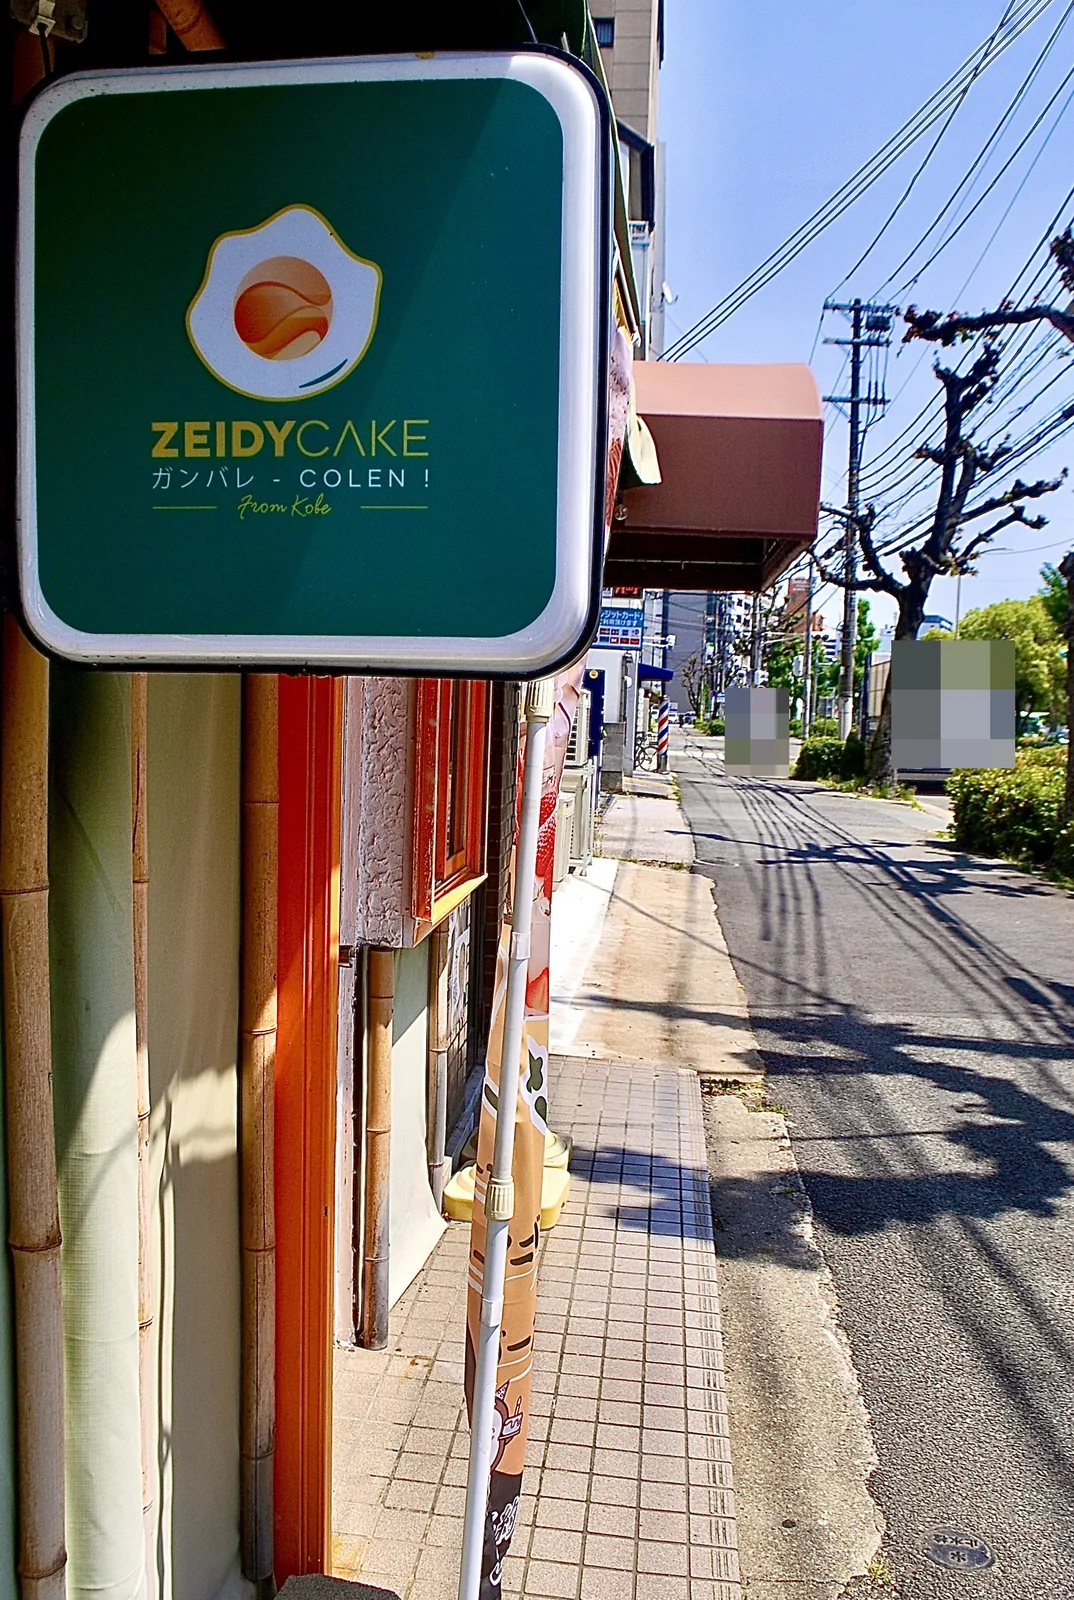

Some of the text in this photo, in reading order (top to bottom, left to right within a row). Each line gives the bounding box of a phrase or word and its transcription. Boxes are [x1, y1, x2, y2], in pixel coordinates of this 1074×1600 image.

[151, 419, 430, 458] ZEIDYCAKE
[152, 467, 254, 490] ガンバレ
[299, 469, 406, 488] COLEN
[237, 493, 332, 520] From Kobe
[933, 1534, 978, 1547] 止水栓
